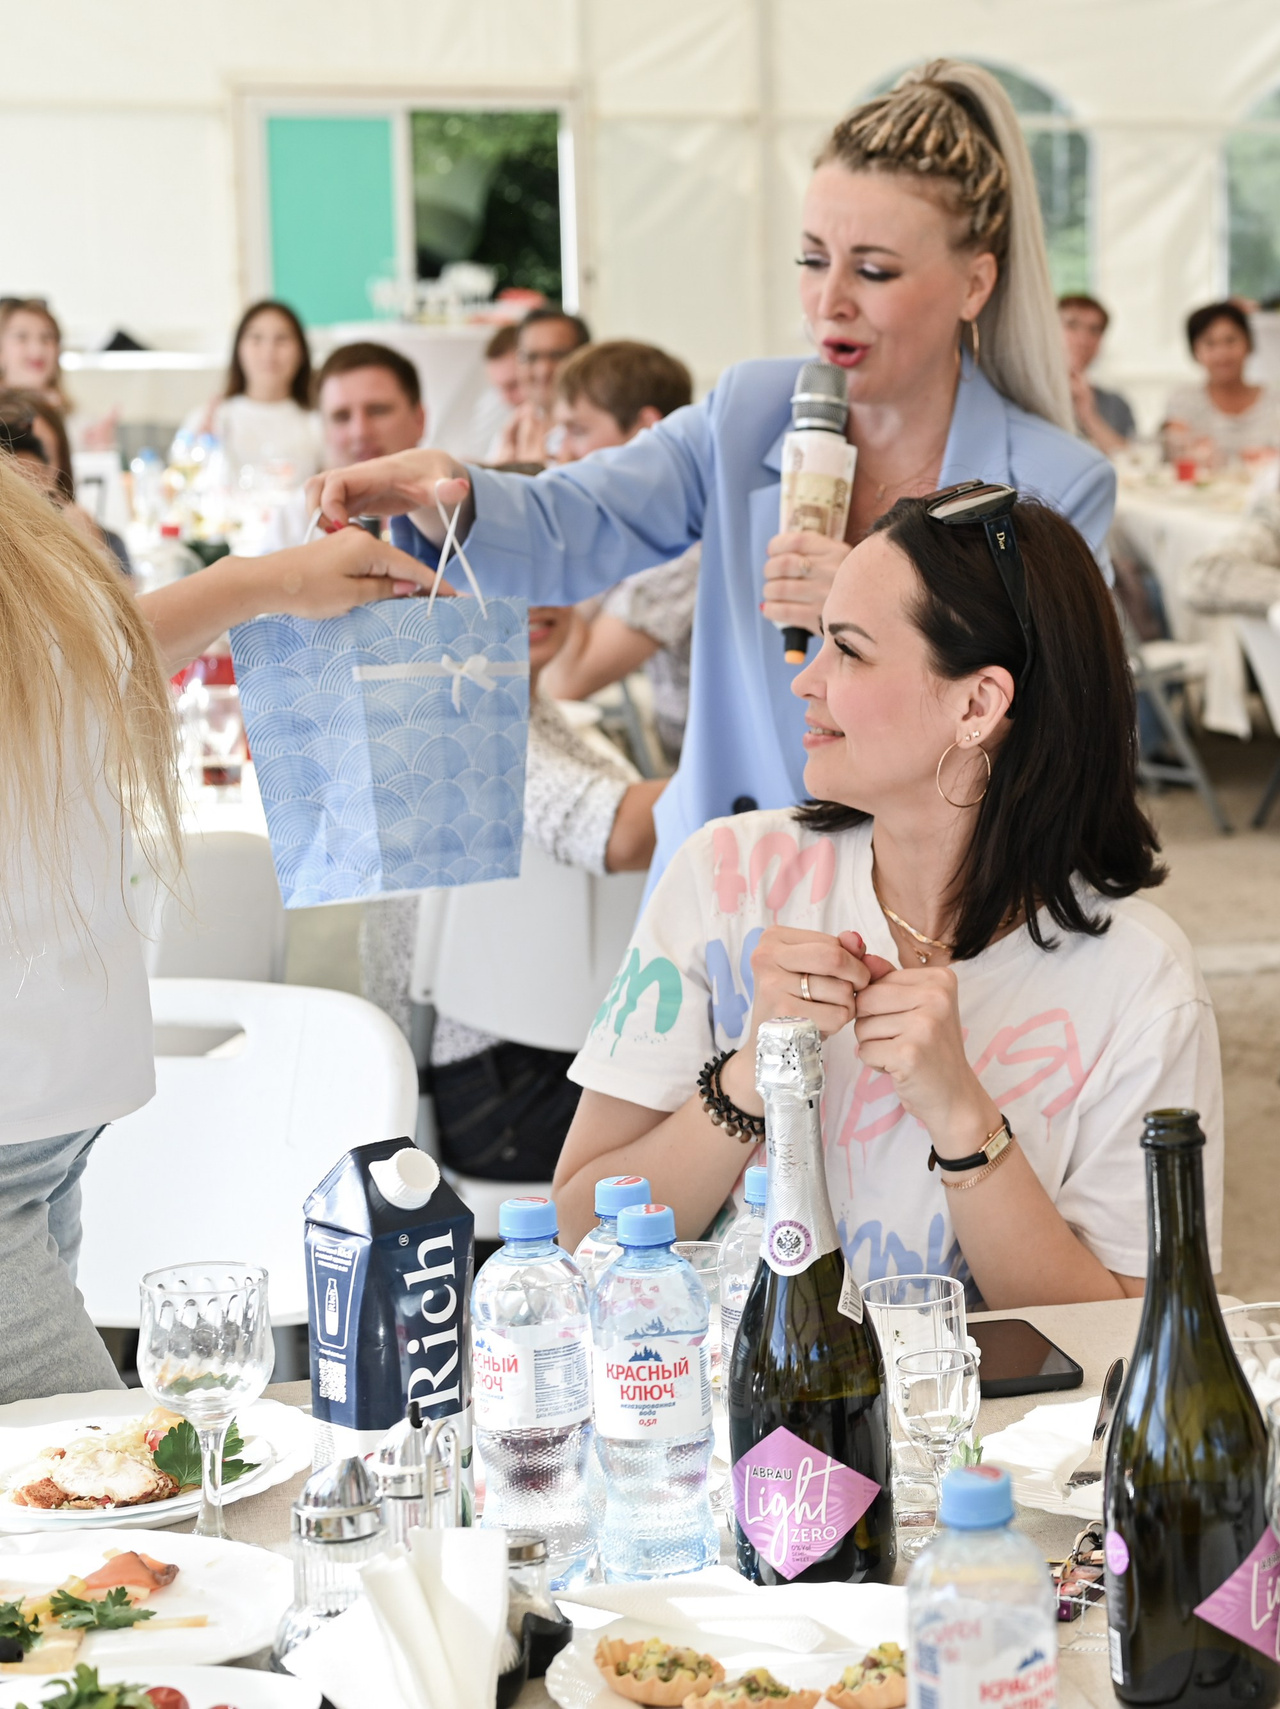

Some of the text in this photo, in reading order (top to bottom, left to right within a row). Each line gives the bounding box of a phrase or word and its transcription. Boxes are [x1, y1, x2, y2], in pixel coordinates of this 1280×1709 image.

[996, 531, 1006, 550] Dior
[606, 1357, 689, 1382] КРАСНЫЙ
[620, 1383, 675, 1401] КЛЮЧ
[620, 1402, 676, 1410] негазированная
[752, 1466, 793, 1481] ABRAU
[744, 1455, 847, 1568] Light
[790, 1525, 837, 1543] ZERO
